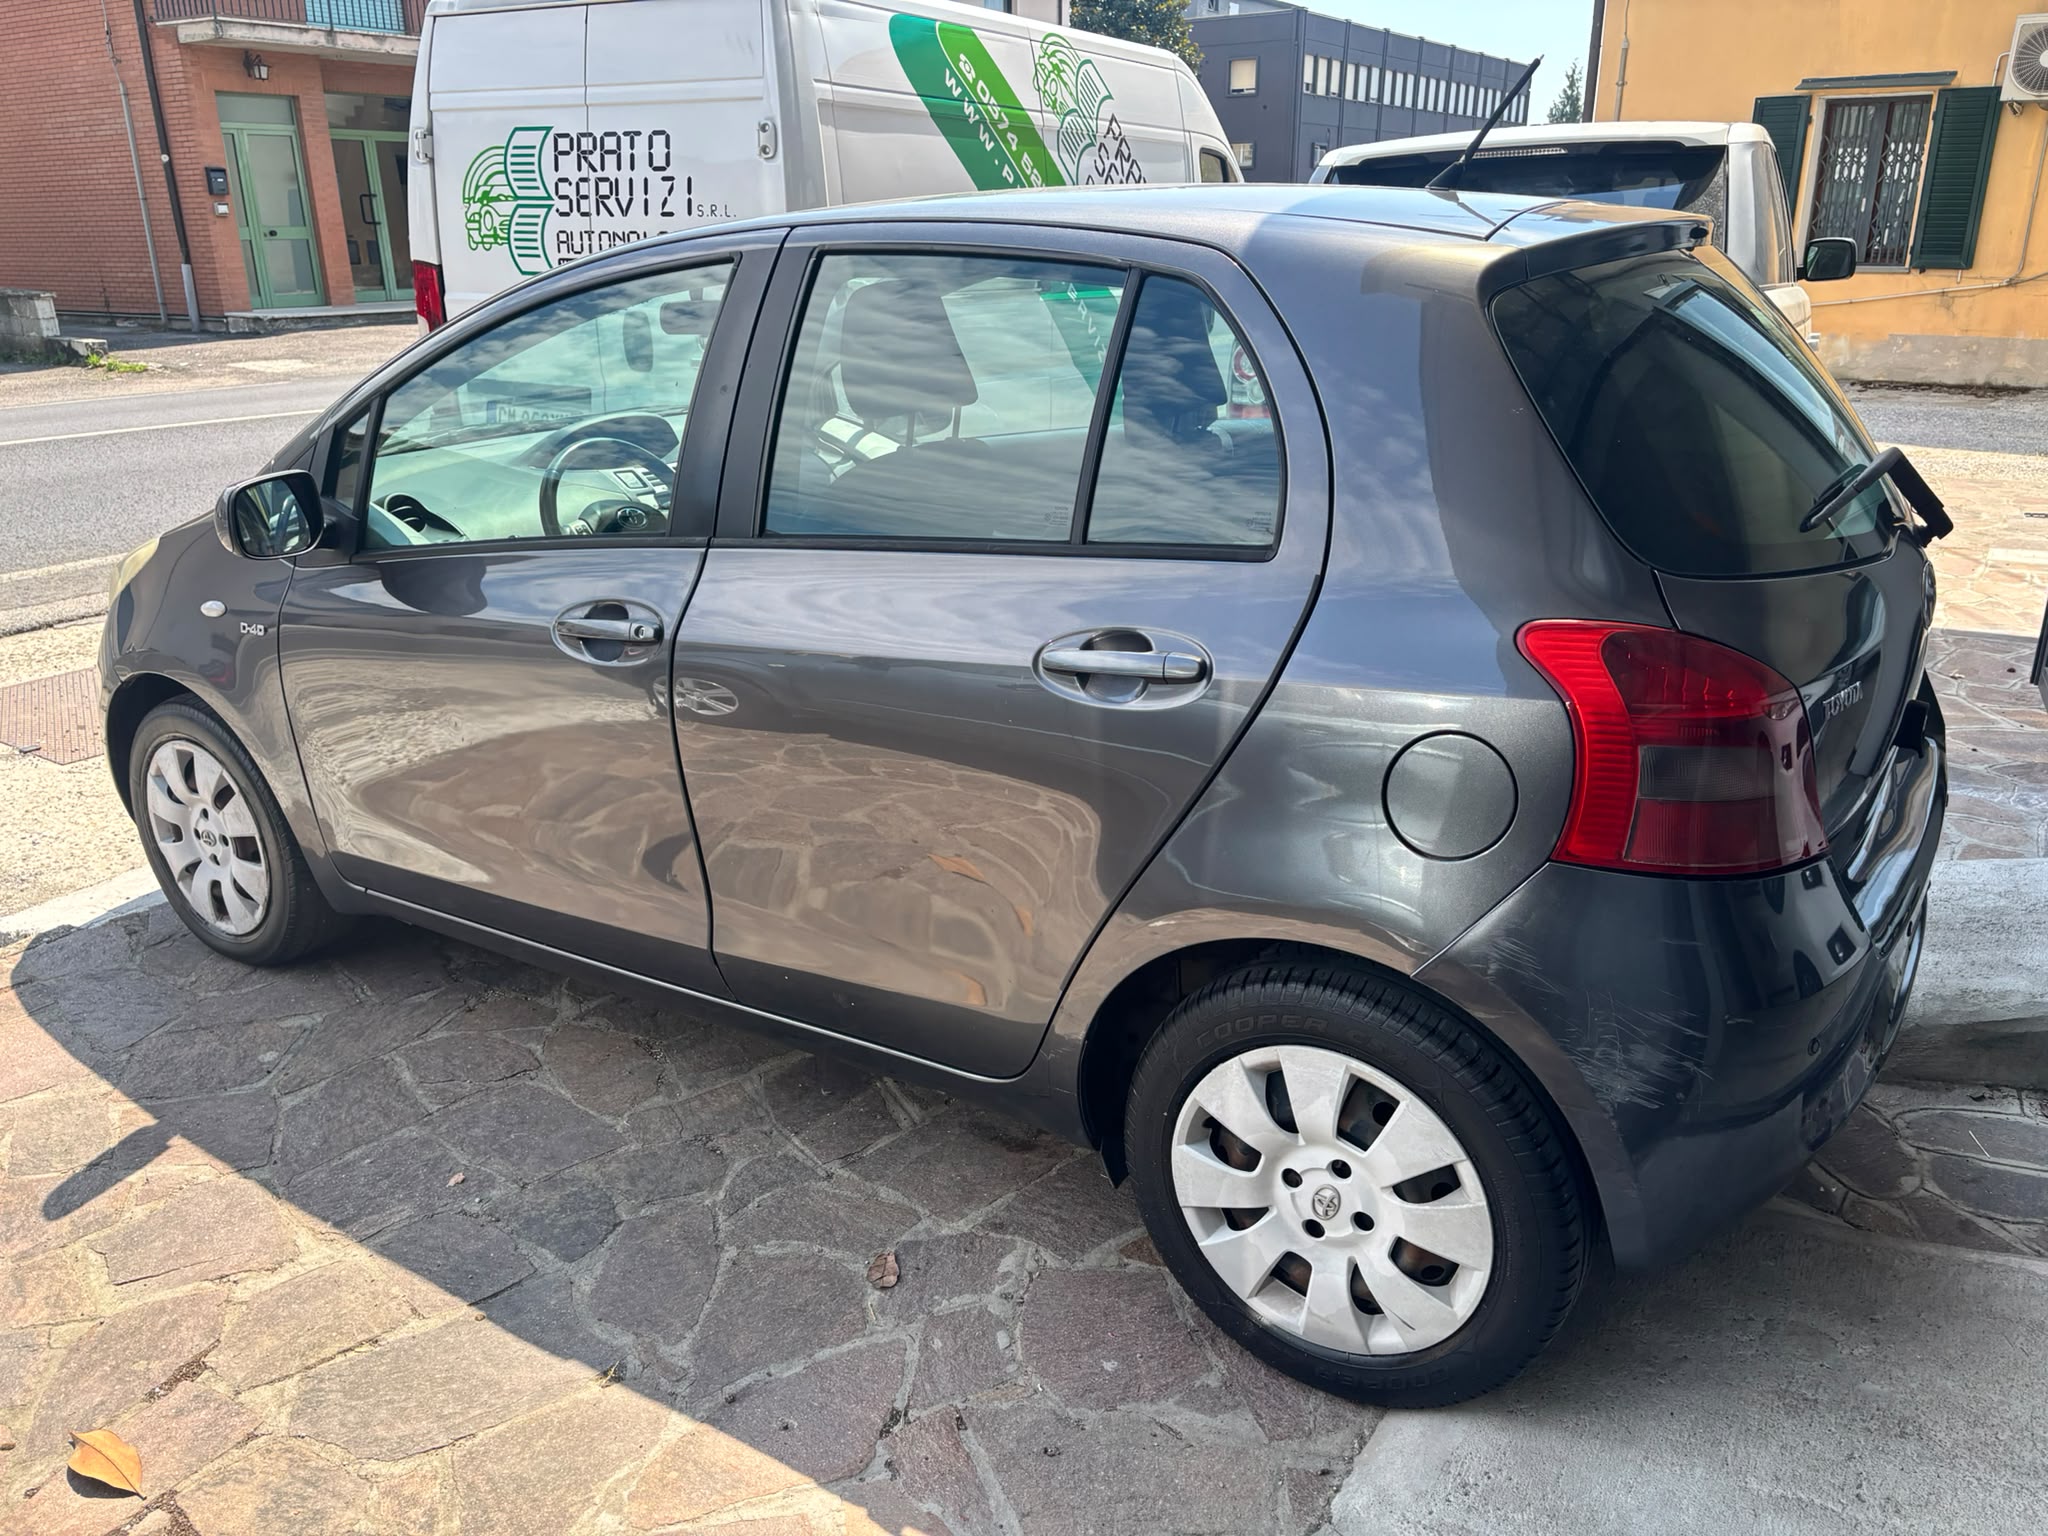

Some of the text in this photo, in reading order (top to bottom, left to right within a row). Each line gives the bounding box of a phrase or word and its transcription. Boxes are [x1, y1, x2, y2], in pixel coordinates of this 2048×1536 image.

[977, 80, 1018, 151] 0574
[553, 130, 671, 173] PRATO
[555, 176, 737, 218] SERVIZI S.R.L.
[1823, 680, 1863, 720] TOYOTA
[1196, 1014, 1329, 1047] COOPER
